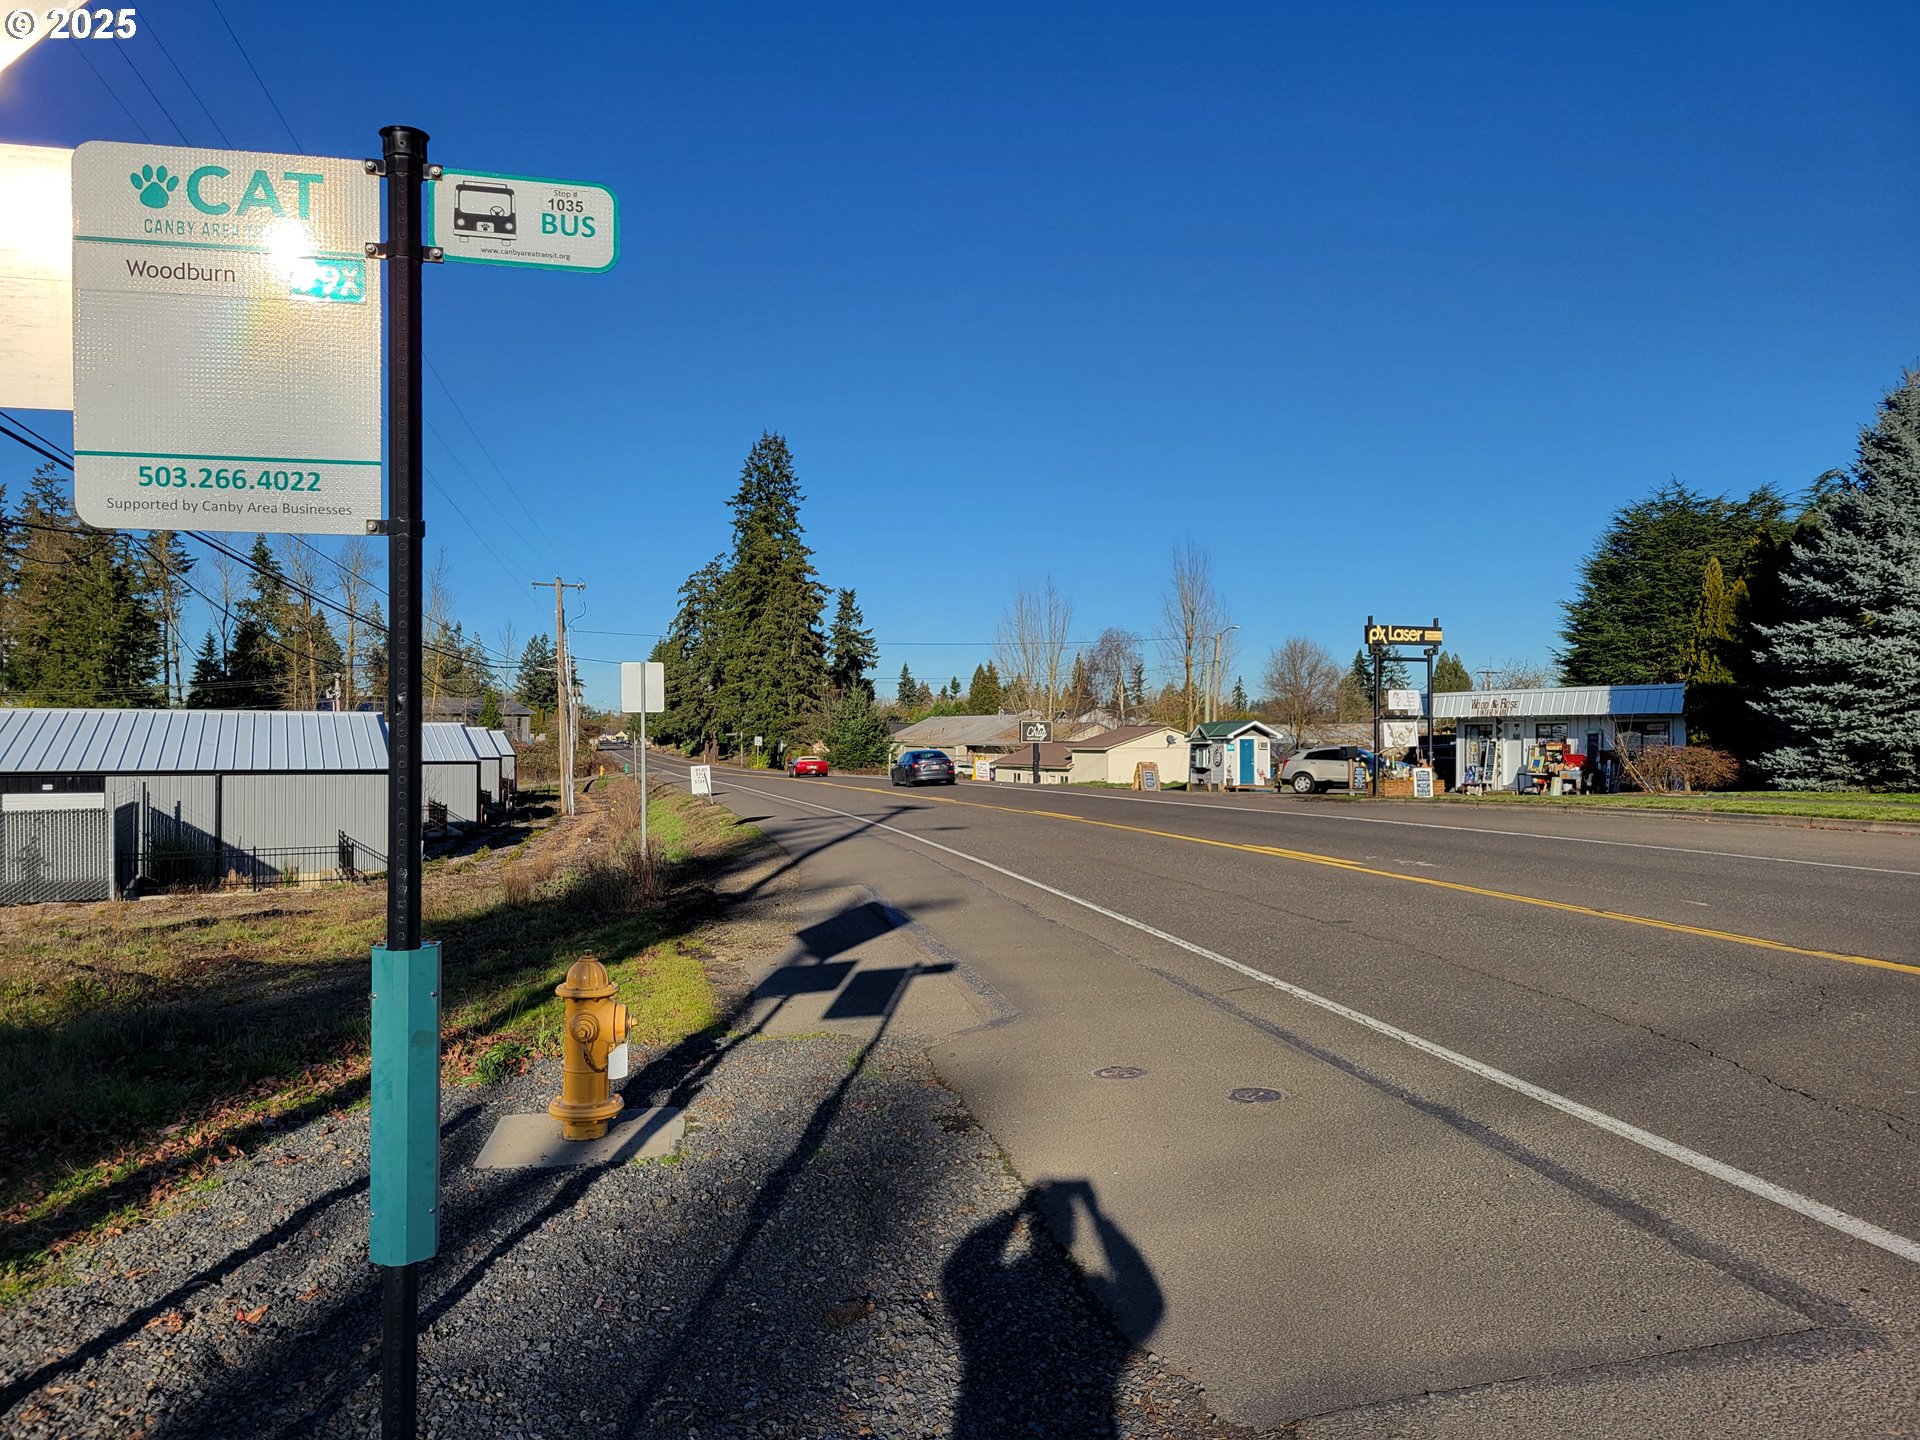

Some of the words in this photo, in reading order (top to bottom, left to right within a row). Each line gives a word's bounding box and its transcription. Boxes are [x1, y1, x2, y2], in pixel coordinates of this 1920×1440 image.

[186, 165, 324, 220] CAT
[553, 189, 571, 199] Stop
[548, 199, 584, 213] 1035
[144, 218, 196, 236] CANBY
[202, 222, 240, 239] AREA
[541, 212, 596, 238] BUS
[480, 247, 571, 261] www.canbyareatransit.org
[126, 259, 236, 283] Woodburn
[138, 465, 322, 492] 503.266.4022
[106, 497, 178, 512] Supported
[182, 499, 199, 514] by
[202, 500, 244, 515] Canby
[247, 502, 278, 514] Area
[282, 503, 353, 516] Businesses
[1388, 625, 1423, 642] Laser
